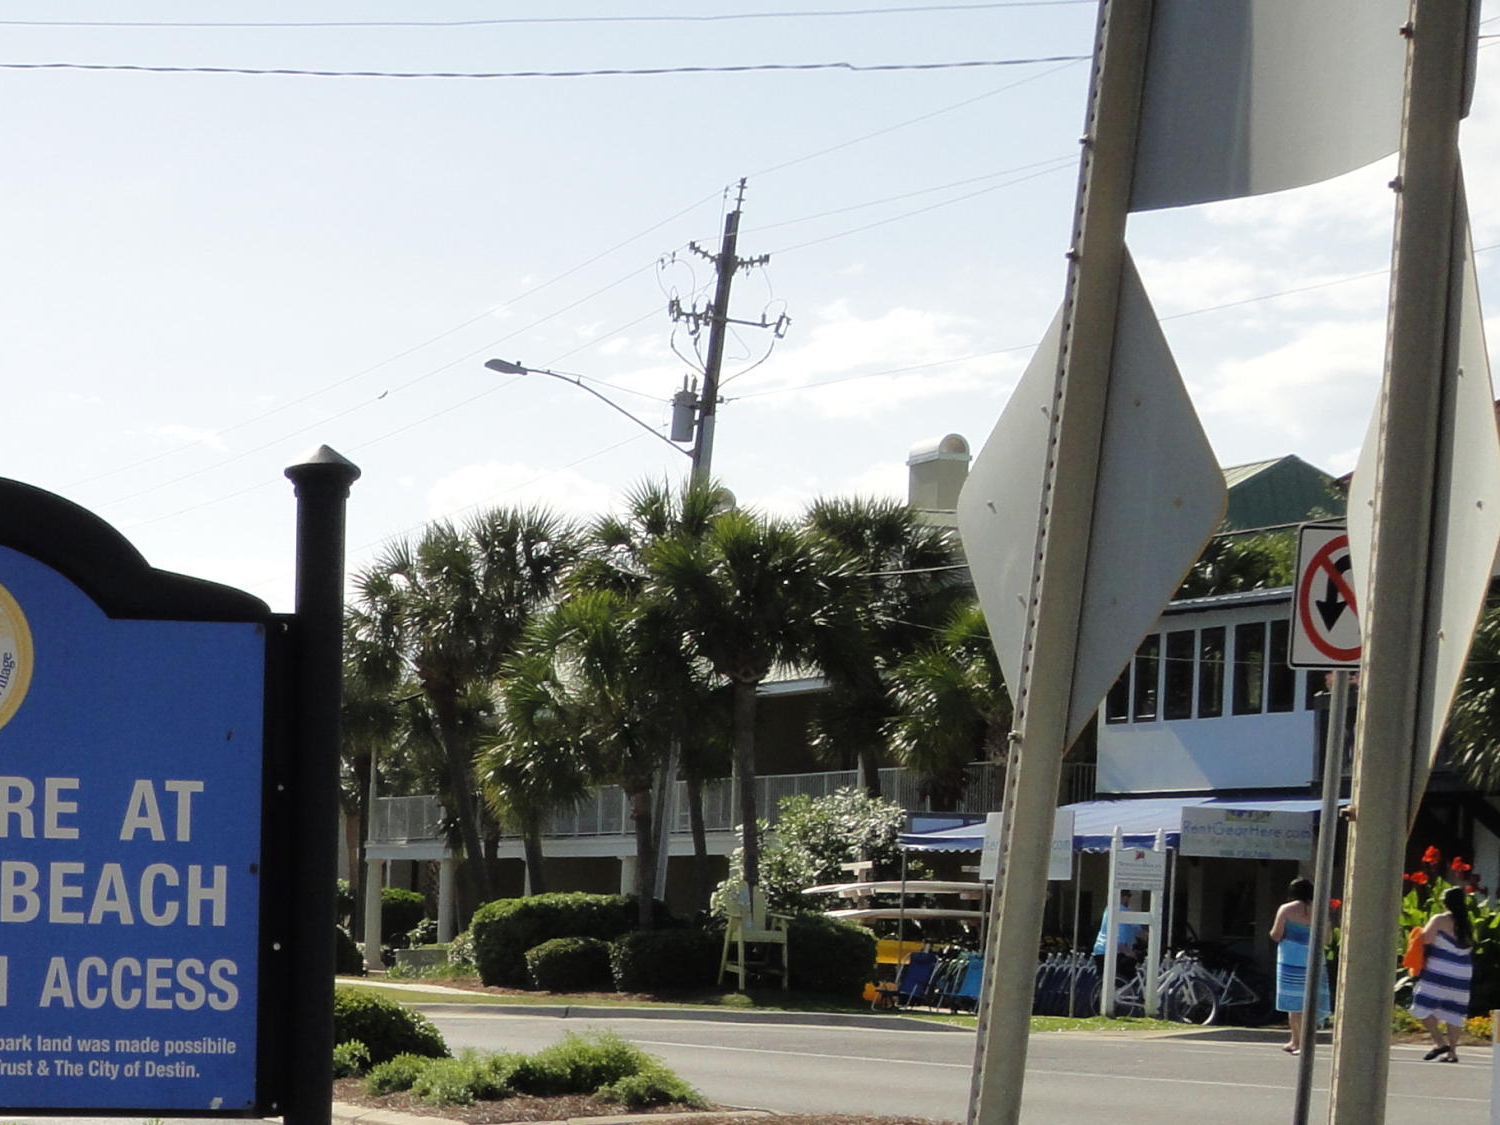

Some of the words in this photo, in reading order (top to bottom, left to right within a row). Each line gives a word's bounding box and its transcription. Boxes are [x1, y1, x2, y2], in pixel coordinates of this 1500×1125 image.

[118, 779, 204, 842] AT
[0, 861, 228, 927] BEACH
[39, 956, 239, 1011] ACCESS
[36, 1060, 50, 1077] &
[54, 1060, 84, 1077] The
[88, 1060, 120, 1081] City
[123, 1060, 140, 1078] of
[144, 1061, 201, 1079] Destin.
[37, 1035, 72, 1052] land
[77, 1038, 110, 1053] was
[115, 1037, 160, 1053] made
[164, 1037, 237, 1057] possibile
